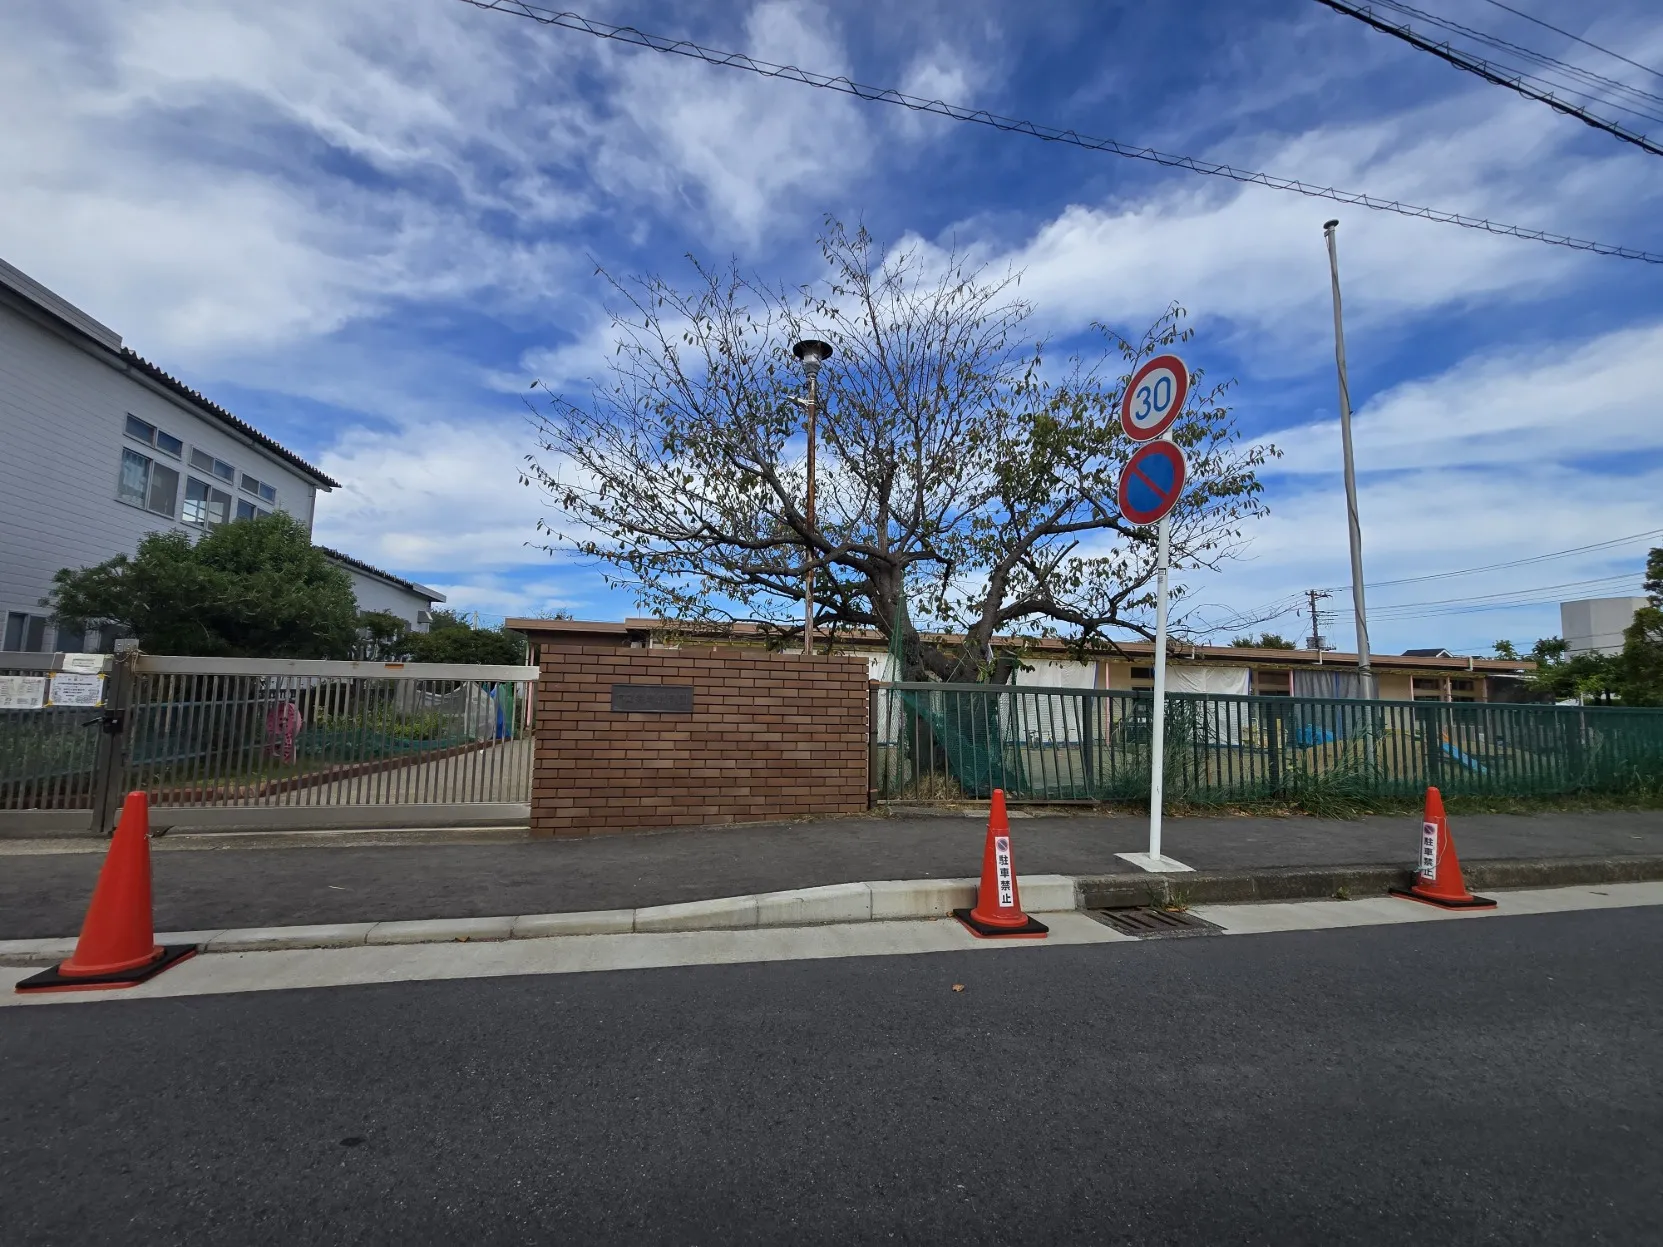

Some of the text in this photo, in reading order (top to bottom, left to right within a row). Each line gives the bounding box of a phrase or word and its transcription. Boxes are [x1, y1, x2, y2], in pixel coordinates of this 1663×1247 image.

[1135, 376, 1171, 420] 30
[998, 854, 1012, 904] 駐車禁止
[1423, 837, 1434, 877] 駐車禁止
